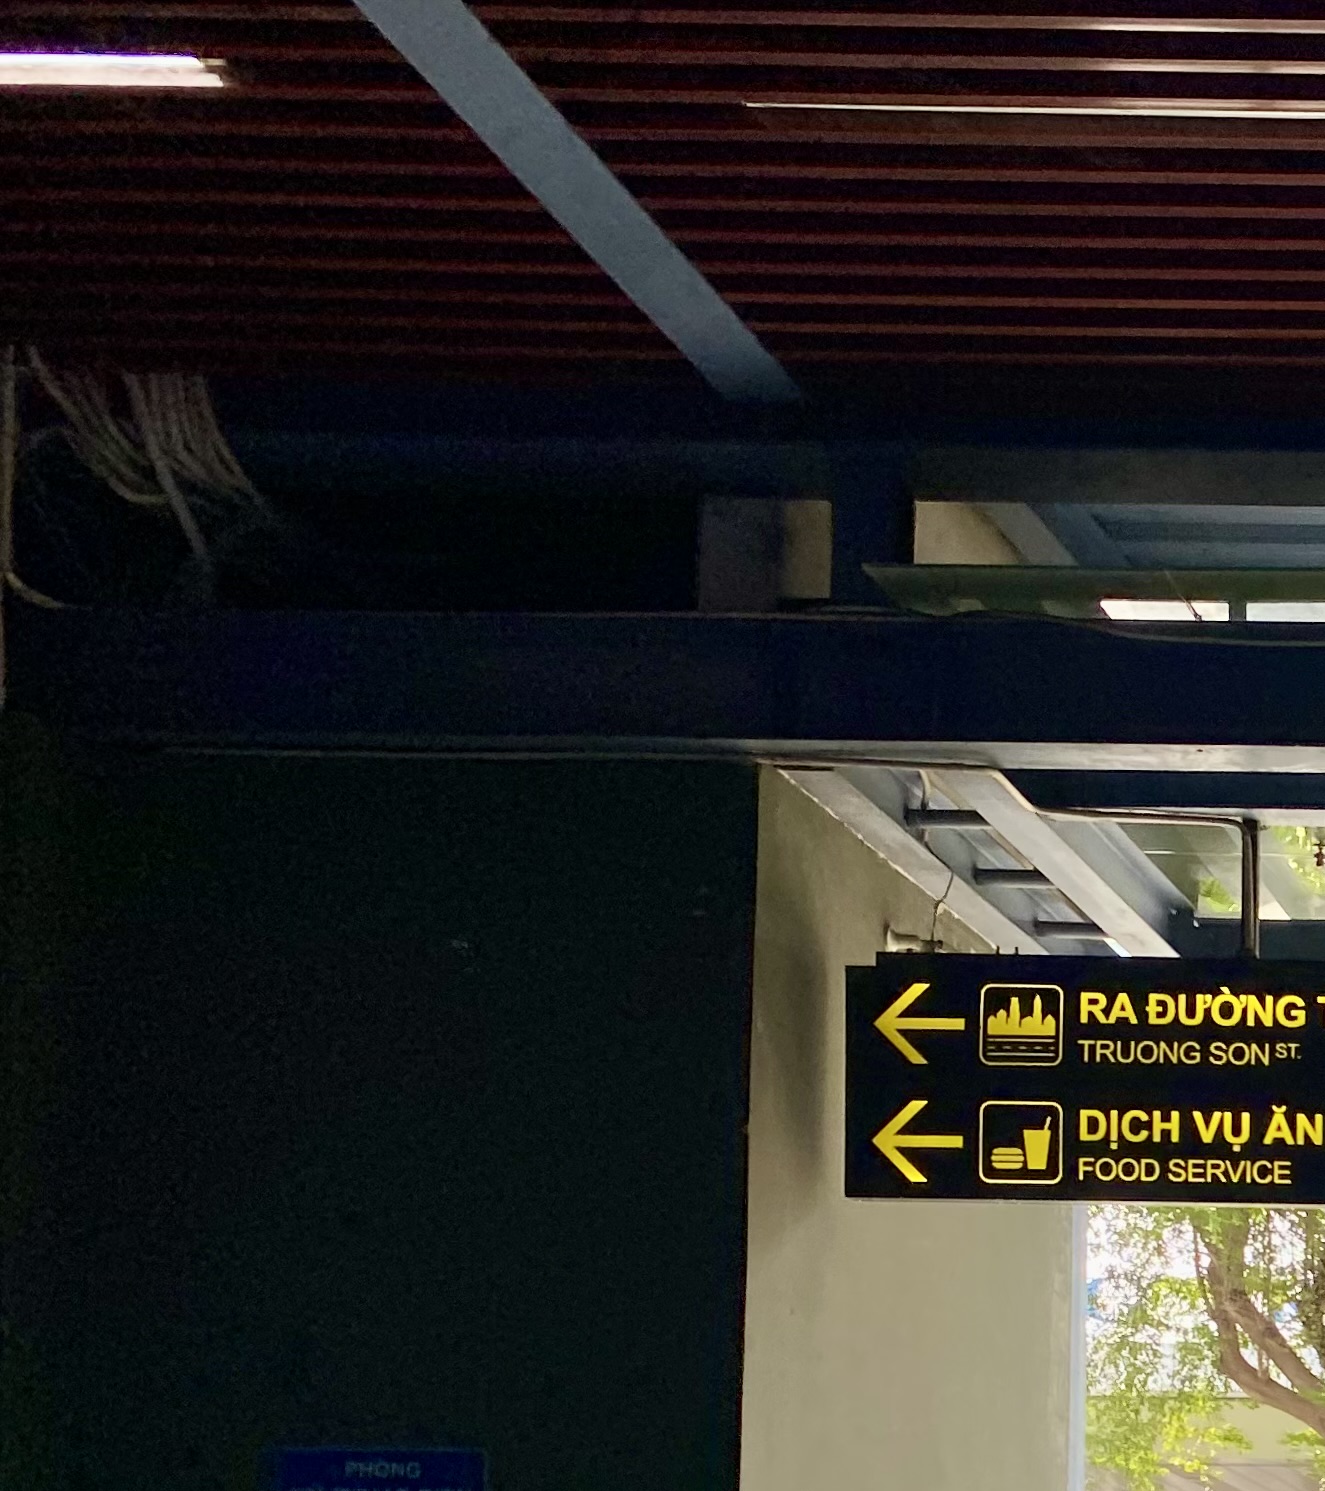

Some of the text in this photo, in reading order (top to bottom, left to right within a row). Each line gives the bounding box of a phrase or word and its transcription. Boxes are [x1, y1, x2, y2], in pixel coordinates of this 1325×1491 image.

[1080, 991, 1137, 1028] RA
[1146, 987, 1306, 1029] ĐƯỜNG
[1079, 1040, 1201, 1064] TRUONG
[1209, 1042, 1270, 1066] SON
[1079, 1109, 1181, 1151] DỊCH
[1192, 1111, 1251, 1152] VỤ
[1263, 1105, 1324, 1146] ĂN
[1078, 1157, 1291, 1185] FOOD SERVICE
